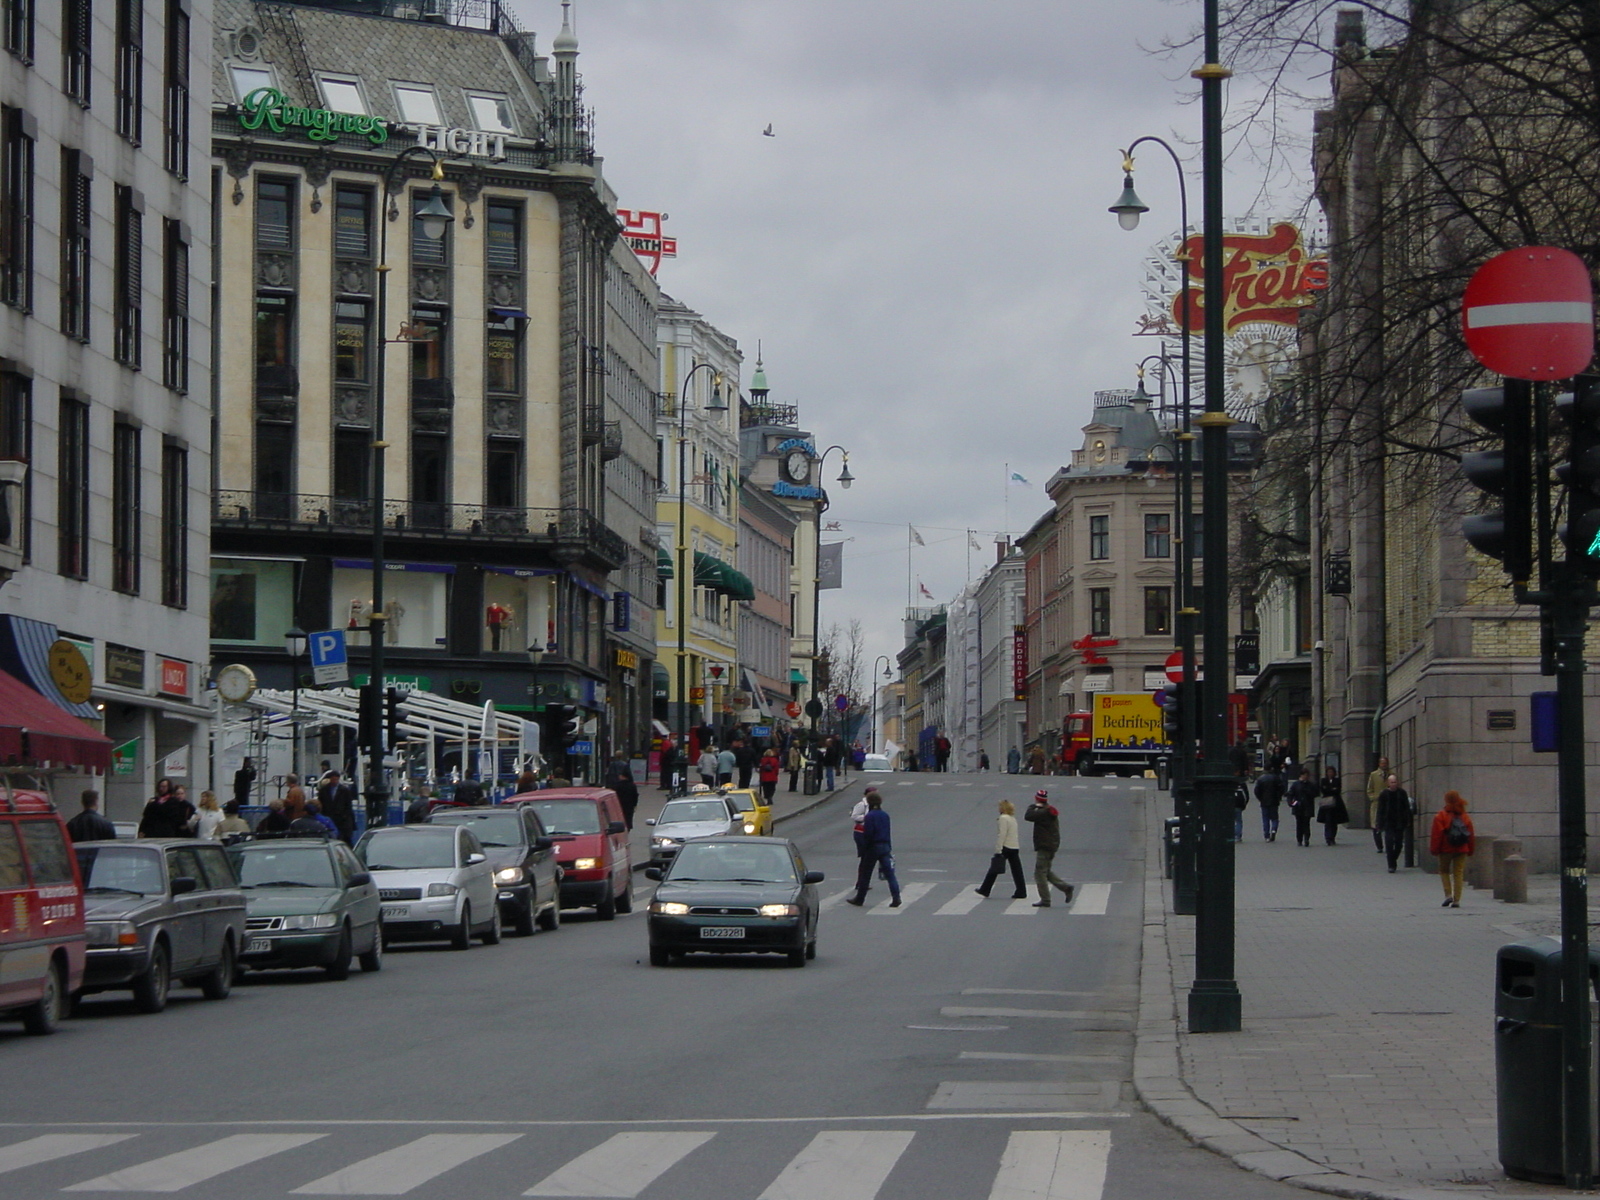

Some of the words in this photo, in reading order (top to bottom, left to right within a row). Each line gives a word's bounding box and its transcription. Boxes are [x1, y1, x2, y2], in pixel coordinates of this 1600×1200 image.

[240, 86, 388, 144] Ringnes
[417, 123, 507, 159] LIGHT
[318, 635, 337, 662] P
